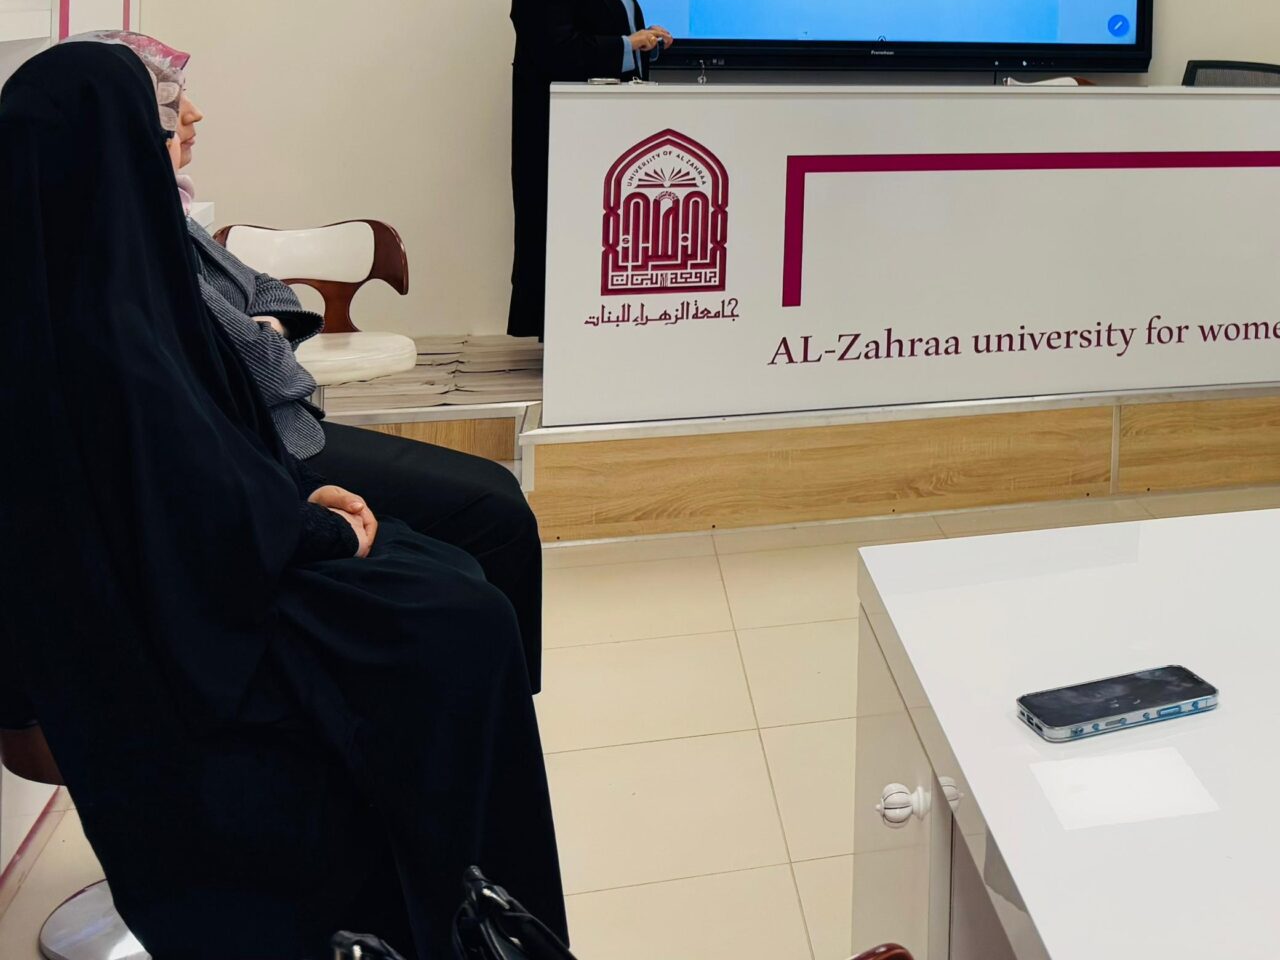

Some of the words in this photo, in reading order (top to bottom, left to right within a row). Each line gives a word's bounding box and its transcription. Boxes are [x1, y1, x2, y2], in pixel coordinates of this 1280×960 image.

[627, 153, 660, 187] UNIVERSITY
[584, 303, 632, 328] للبنات
[632, 300, 690, 326] الزهراء
[692, 298, 740, 321] جامعة
[767, 327, 962, 366] AL-Zahraa
[972, 321, 1137, 357] university
[1145, 315, 1190, 345] for
